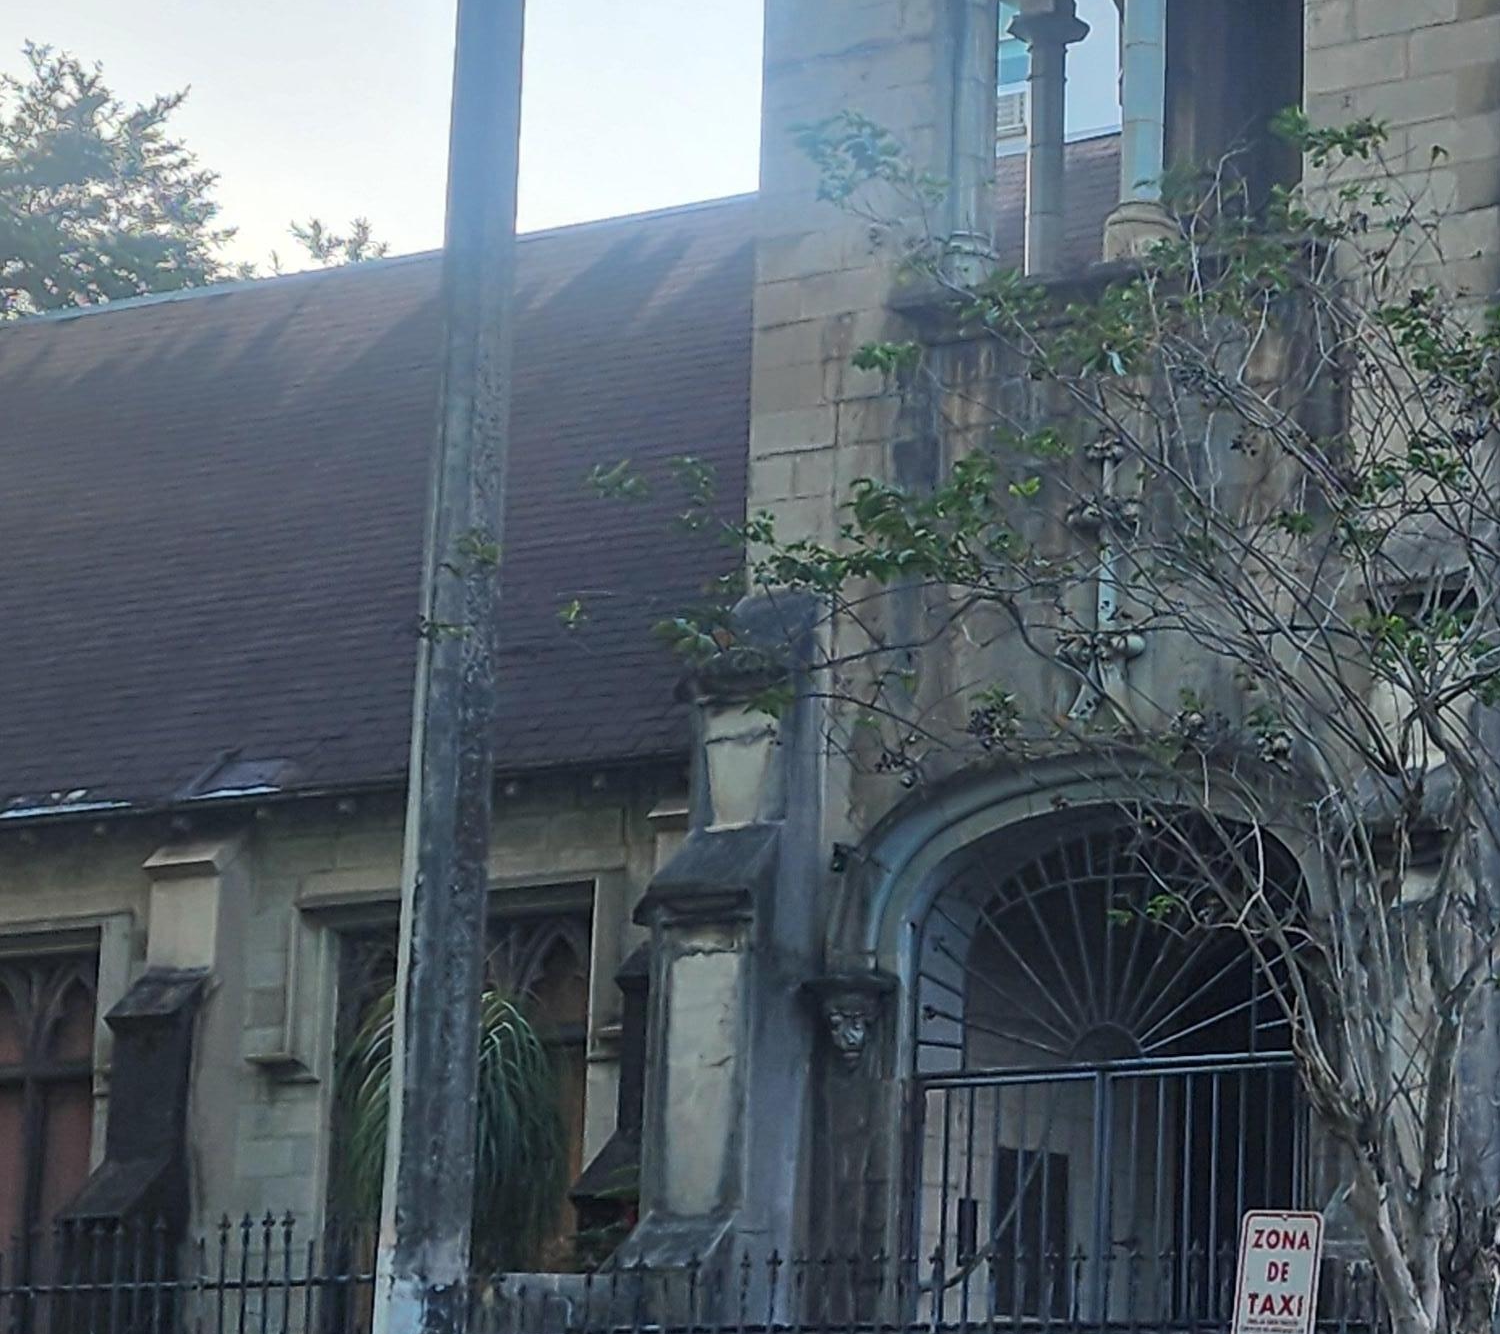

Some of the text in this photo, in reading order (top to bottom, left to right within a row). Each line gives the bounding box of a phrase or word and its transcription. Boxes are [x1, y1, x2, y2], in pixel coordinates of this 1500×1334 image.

[1252, 1229, 1310, 1250] ZONA
[1267, 1261, 1290, 1282] DE
[1248, 1292, 1304, 1317] TAXI
